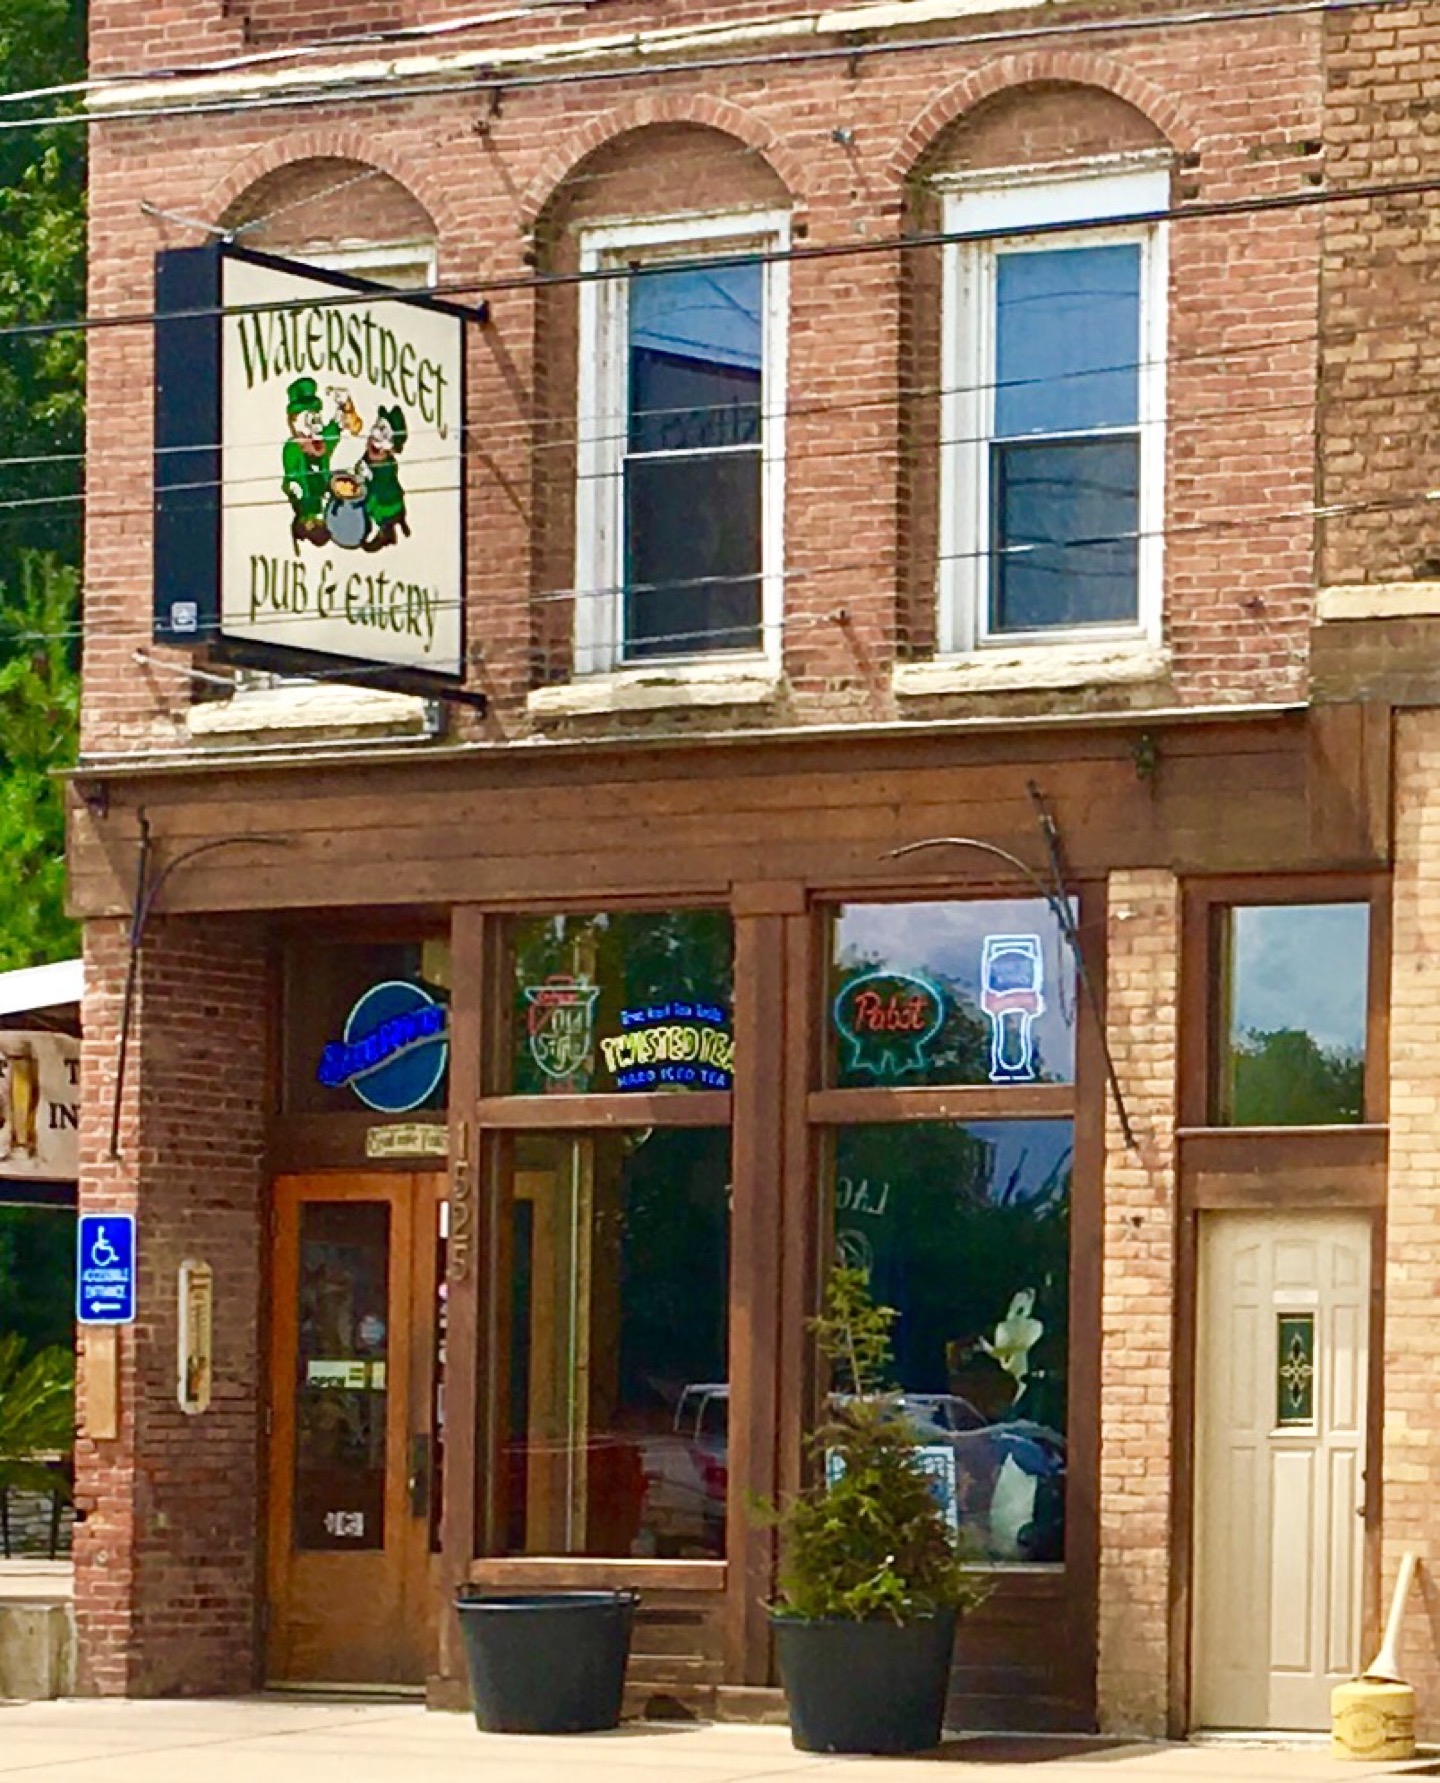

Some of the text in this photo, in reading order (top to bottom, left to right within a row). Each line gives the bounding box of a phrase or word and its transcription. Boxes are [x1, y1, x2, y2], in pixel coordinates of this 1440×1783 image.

[317, 559, 337, 618] &
[854, 991, 928, 1032] Pabst
[600, 1026, 700, 1073] TWISTED
[701, 1069, 727, 1086] TEA
